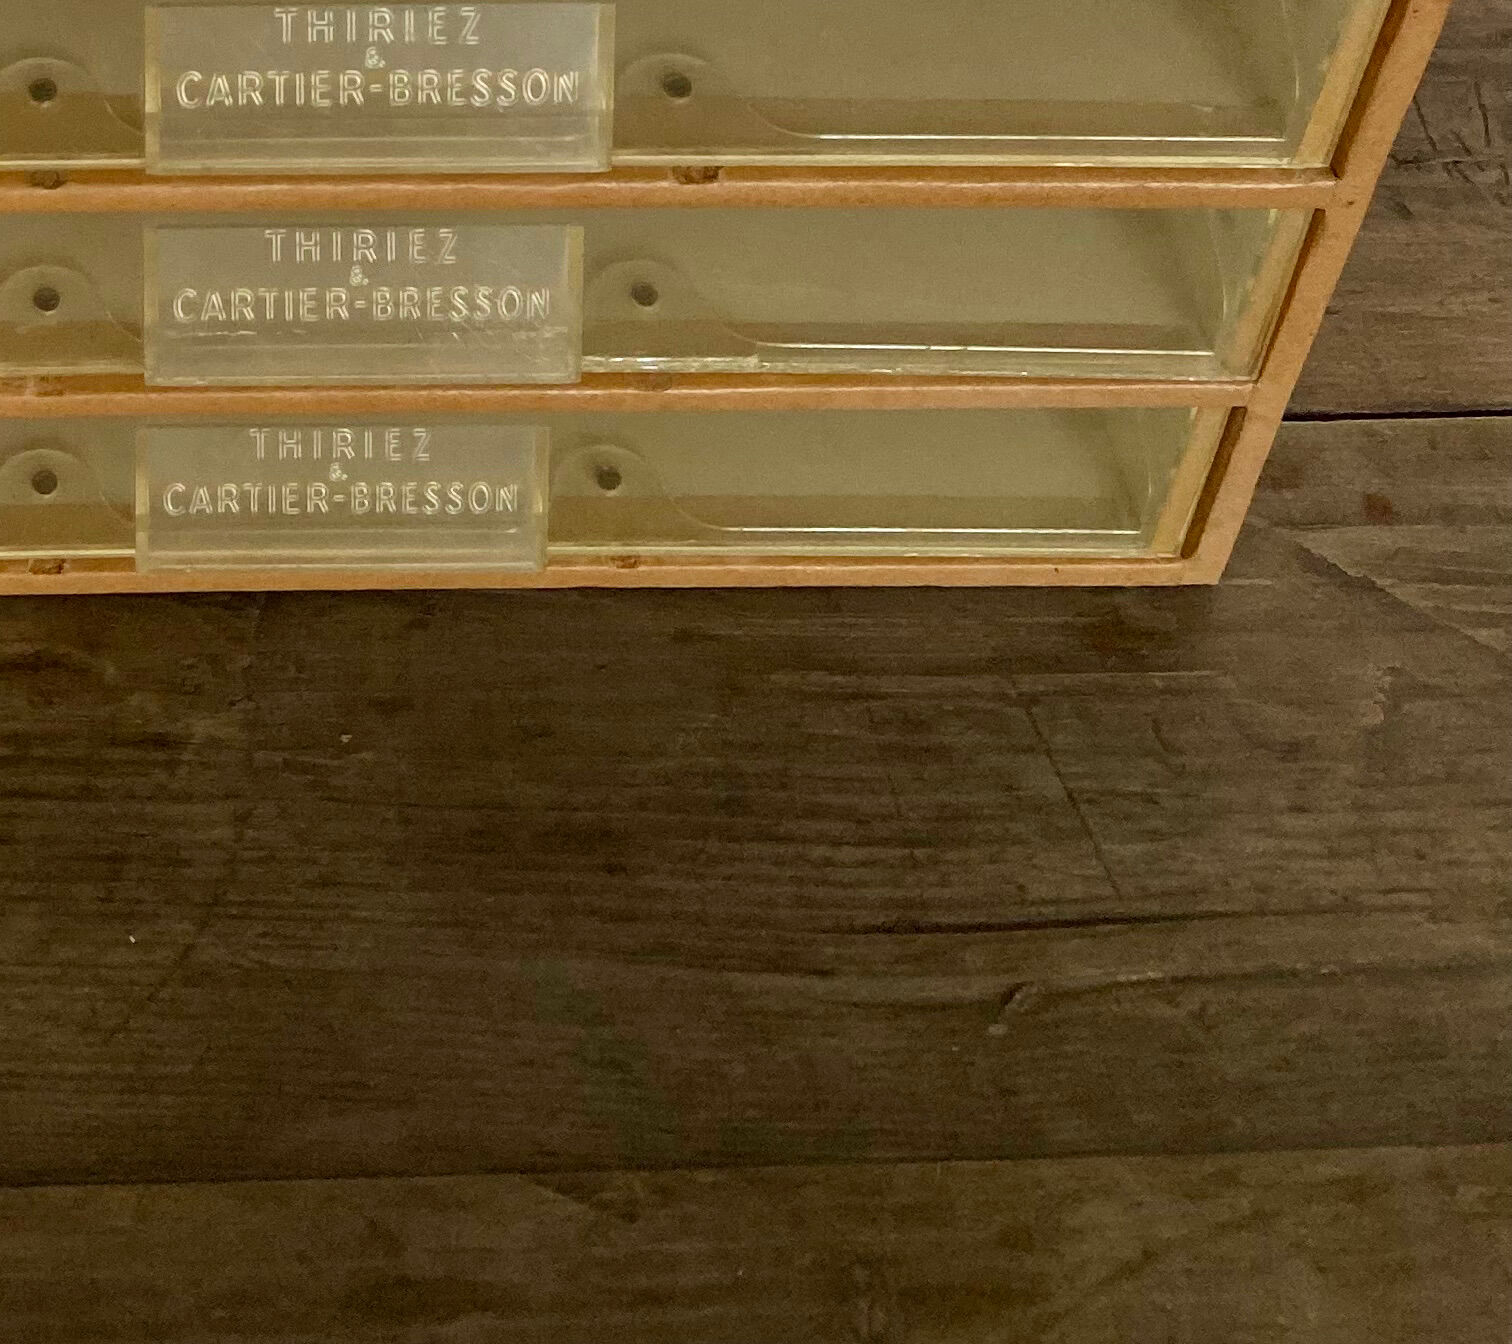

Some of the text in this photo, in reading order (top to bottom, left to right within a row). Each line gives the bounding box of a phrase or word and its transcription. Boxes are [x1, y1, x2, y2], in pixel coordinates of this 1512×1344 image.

[274, 6, 481, 45] THIRIEZ
[364, 46, 386, 69] &
[176, 69, 580, 109] CARTIER-BRESSON
[264, 229, 459, 264] THIRIEZ
[172, 287, 550, 323] CARTIER-BRESSON
[249, 428, 431, 461] THIRIEZ
[162, 482, 518, 516] CARTIER-BRESSON
